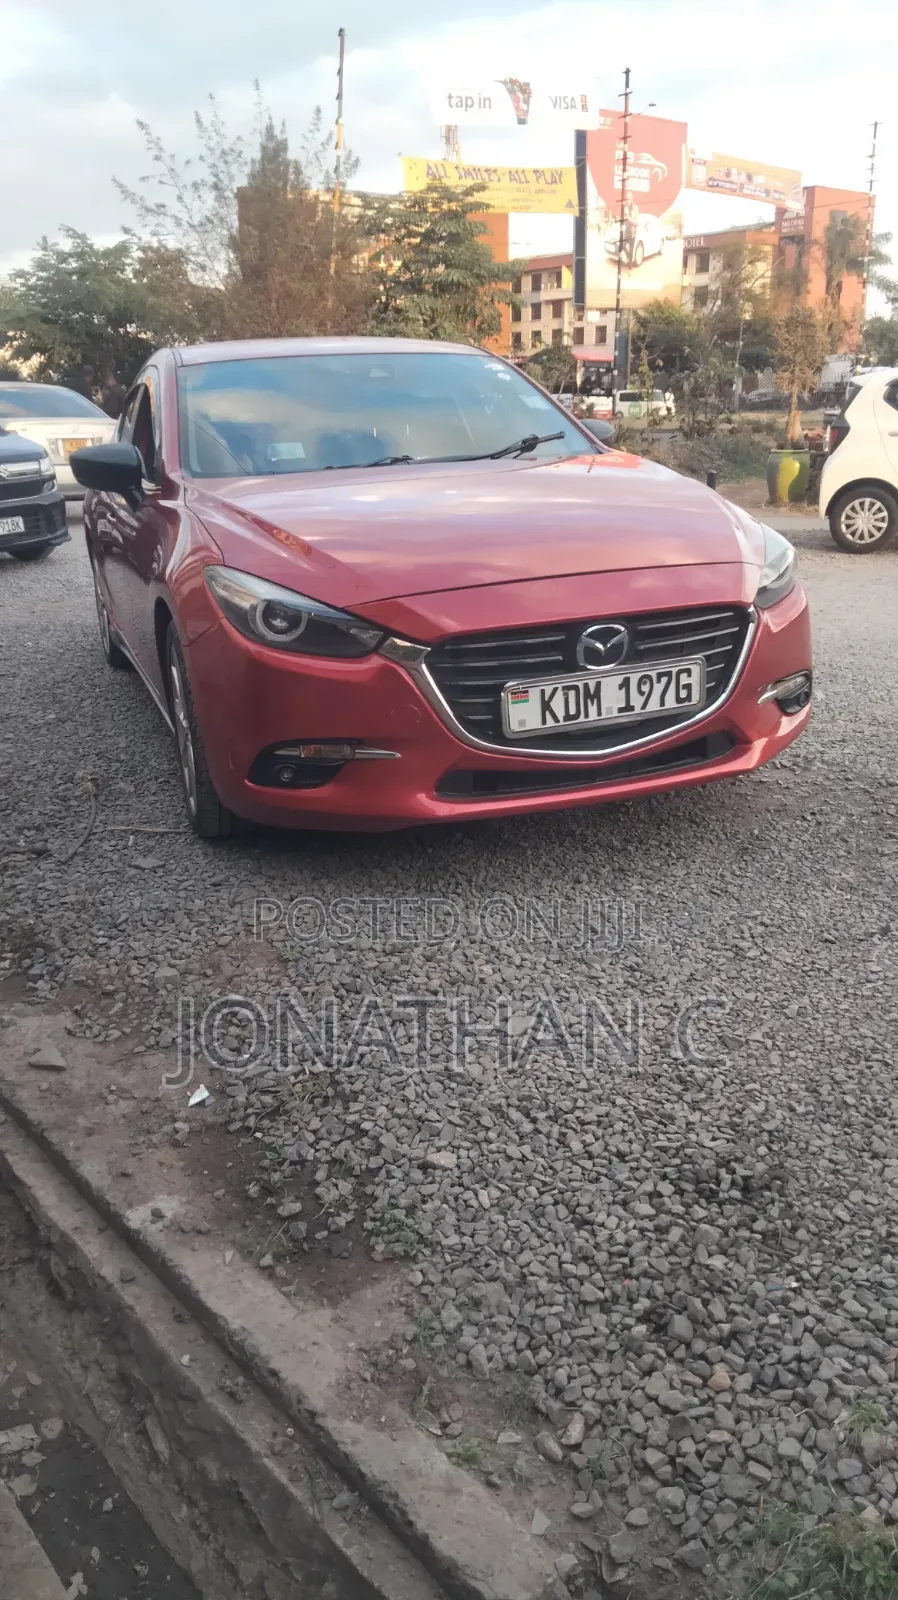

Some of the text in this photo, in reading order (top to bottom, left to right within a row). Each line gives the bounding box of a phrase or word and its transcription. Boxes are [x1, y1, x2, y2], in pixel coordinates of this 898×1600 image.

[447, 92, 474, 112] tap
[478, 92, 492, 109] in
[548, 95, 577, 111] VISA
[426, 162, 563, 186] ALL SMILES ALL PLAY
[0, 518, 22, 533] 918K
[540, 667, 692, 726] KDM 197G
